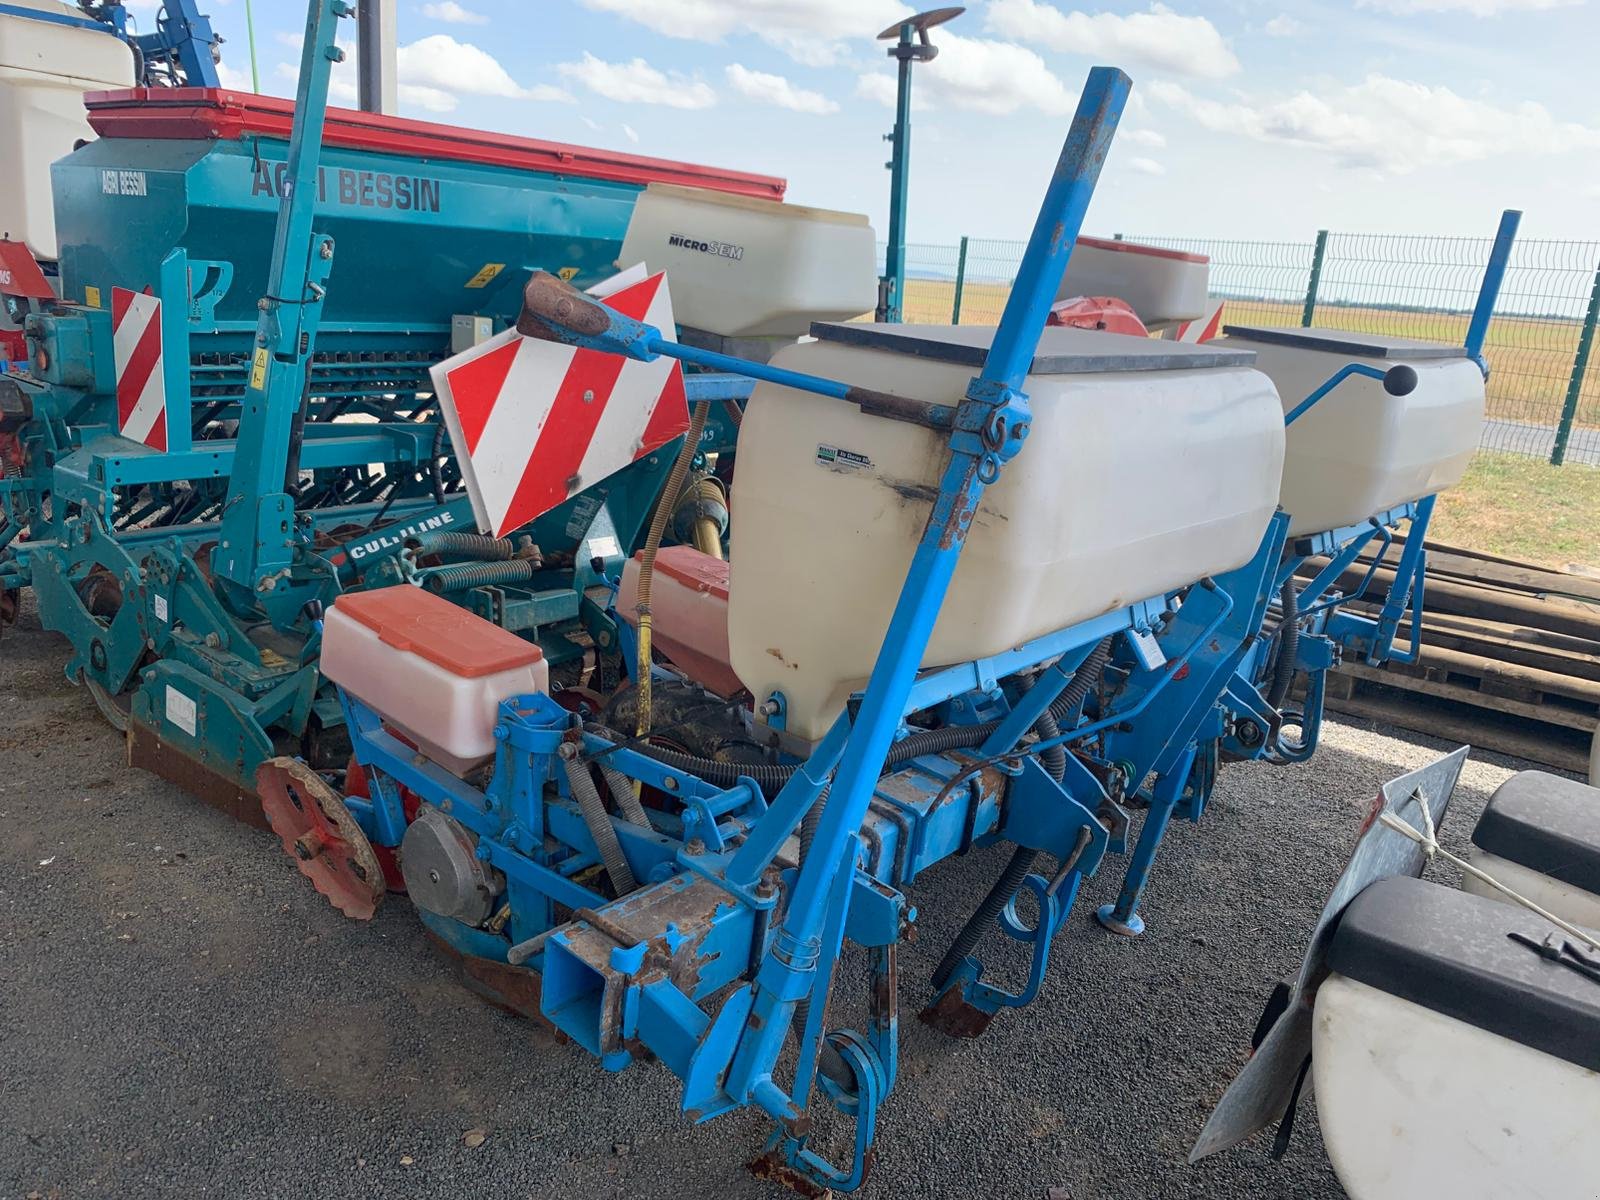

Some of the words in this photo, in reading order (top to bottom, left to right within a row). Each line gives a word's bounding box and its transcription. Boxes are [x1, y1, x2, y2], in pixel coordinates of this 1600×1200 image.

[120, 170, 147, 196] BESSIN
[338, 169, 440, 213] BESSIN
[669, 236, 744, 261] MICROSEM
